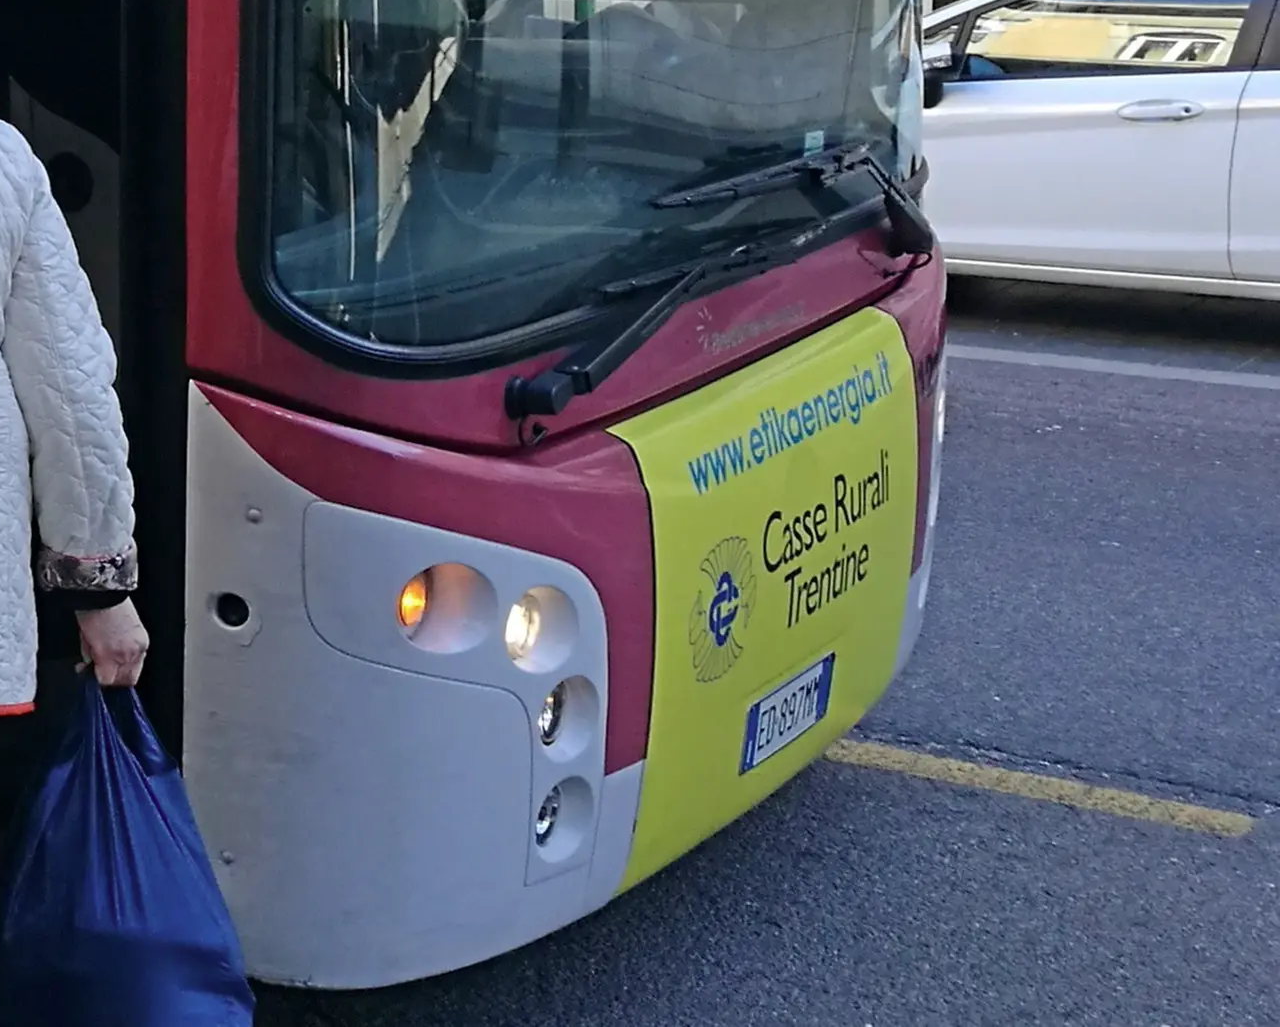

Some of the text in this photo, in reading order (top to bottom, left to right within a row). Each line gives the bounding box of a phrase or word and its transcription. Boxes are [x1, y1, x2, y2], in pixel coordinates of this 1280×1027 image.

[687, 350, 894, 495] www.etikaenergia.it
[762, 449, 890, 574] Casse Rurali
[784, 542, 870, 630] Trentine
